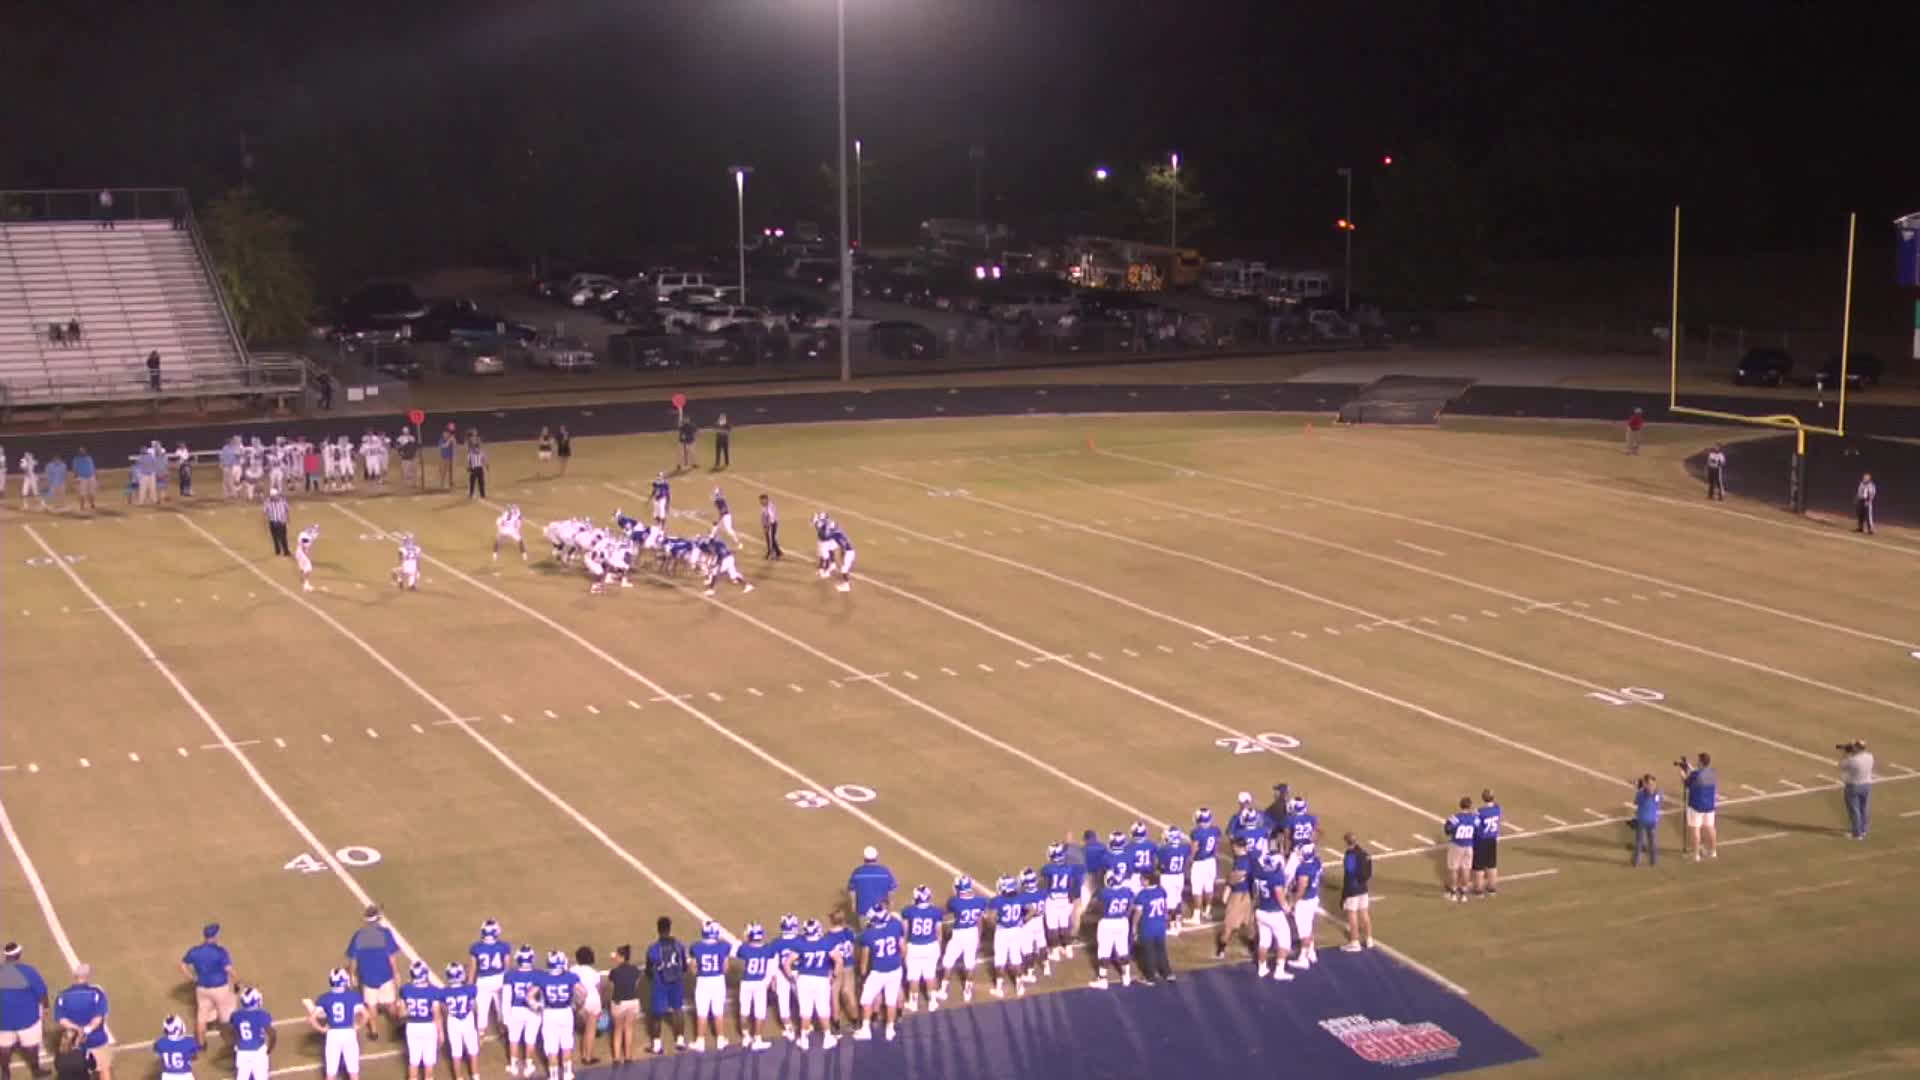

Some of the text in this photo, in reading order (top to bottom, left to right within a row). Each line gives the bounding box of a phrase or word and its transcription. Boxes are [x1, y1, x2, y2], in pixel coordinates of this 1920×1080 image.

[1584, 687, 1664, 704] 10
[1216, 732, 1300, 754] 20
[784, 785, 877, 808] 30
[1293, 823, 1312, 840] 22
[1483, 816, 1499, 833] 75
[283, 846, 381, 873] 40
[1135, 849, 1151, 867] 31
[1051, 874, 1069, 889] 14
[1001, 904, 1022, 921] 30
[911, 918, 933, 936] 68
[874, 936, 896, 957] 72
[478, 953, 502, 970] 34
[701, 954, 720, 971] 51
[747, 957, 767, 974] 81
[804, 950, 826, 968] 77
[546, 985, 571, 1003] 55
[332, 1001, 346, 1023] 9
[407, 999, 430, 1018] 25
[446, 996, 468, 1015] 27
[239, 1021, 253, 1042] 6
[162, 1051, 185, 1070] 16
